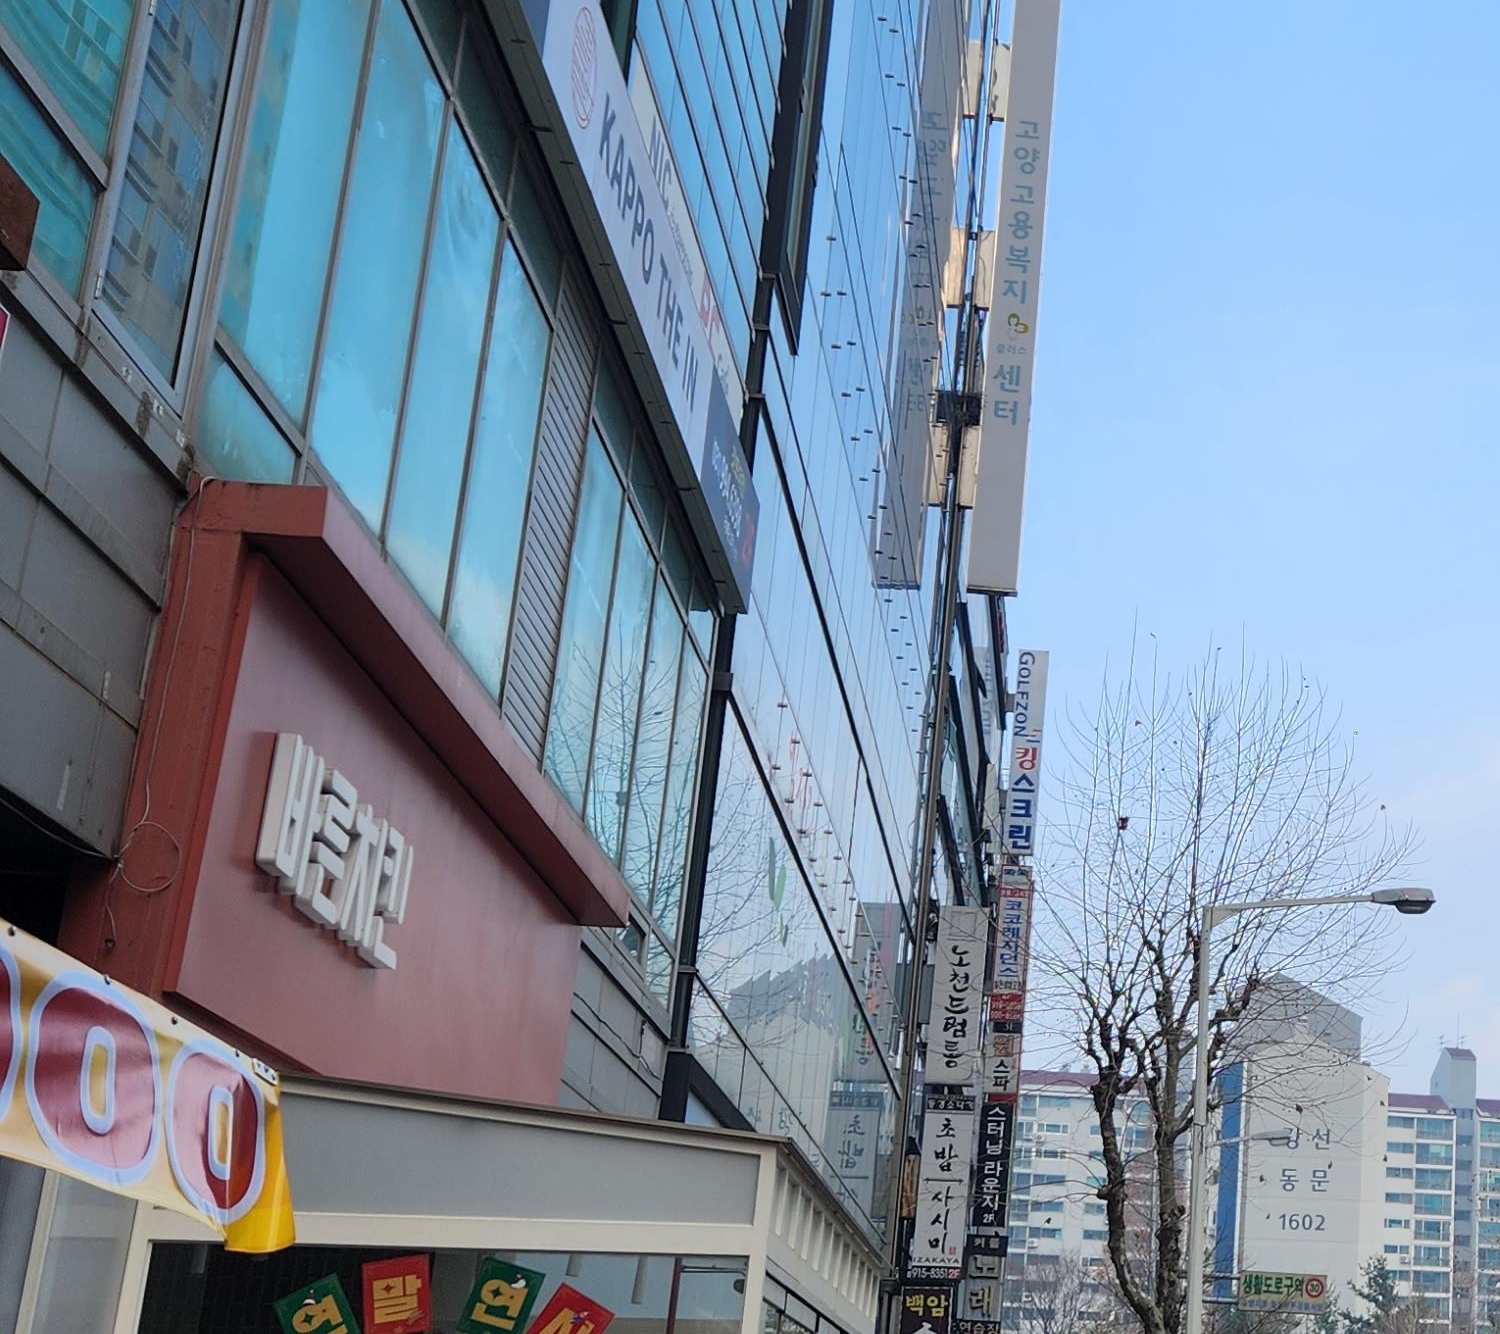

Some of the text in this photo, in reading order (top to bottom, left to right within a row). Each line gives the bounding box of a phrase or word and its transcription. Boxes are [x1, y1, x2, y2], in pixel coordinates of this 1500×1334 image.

[600, 91, 654, 285] KAPPO
[656, 253, 684, 367] THE
[992, 364, 1022, 425] 센터
[1014, 652, 1035, 737] GOLFZON
[256, 732, 414, 969] 바른치킨
[934, 1118, 959, 1172] 초밥
[1280, 1169, 1330, 1192] 동문
[928, 1186, 954, 1254] 사시미
[1279, 1214, 1326, 1231] 1602
[948, 1269, 961, 1279] 2F
[905, 1295, 948, 1317] 백암
